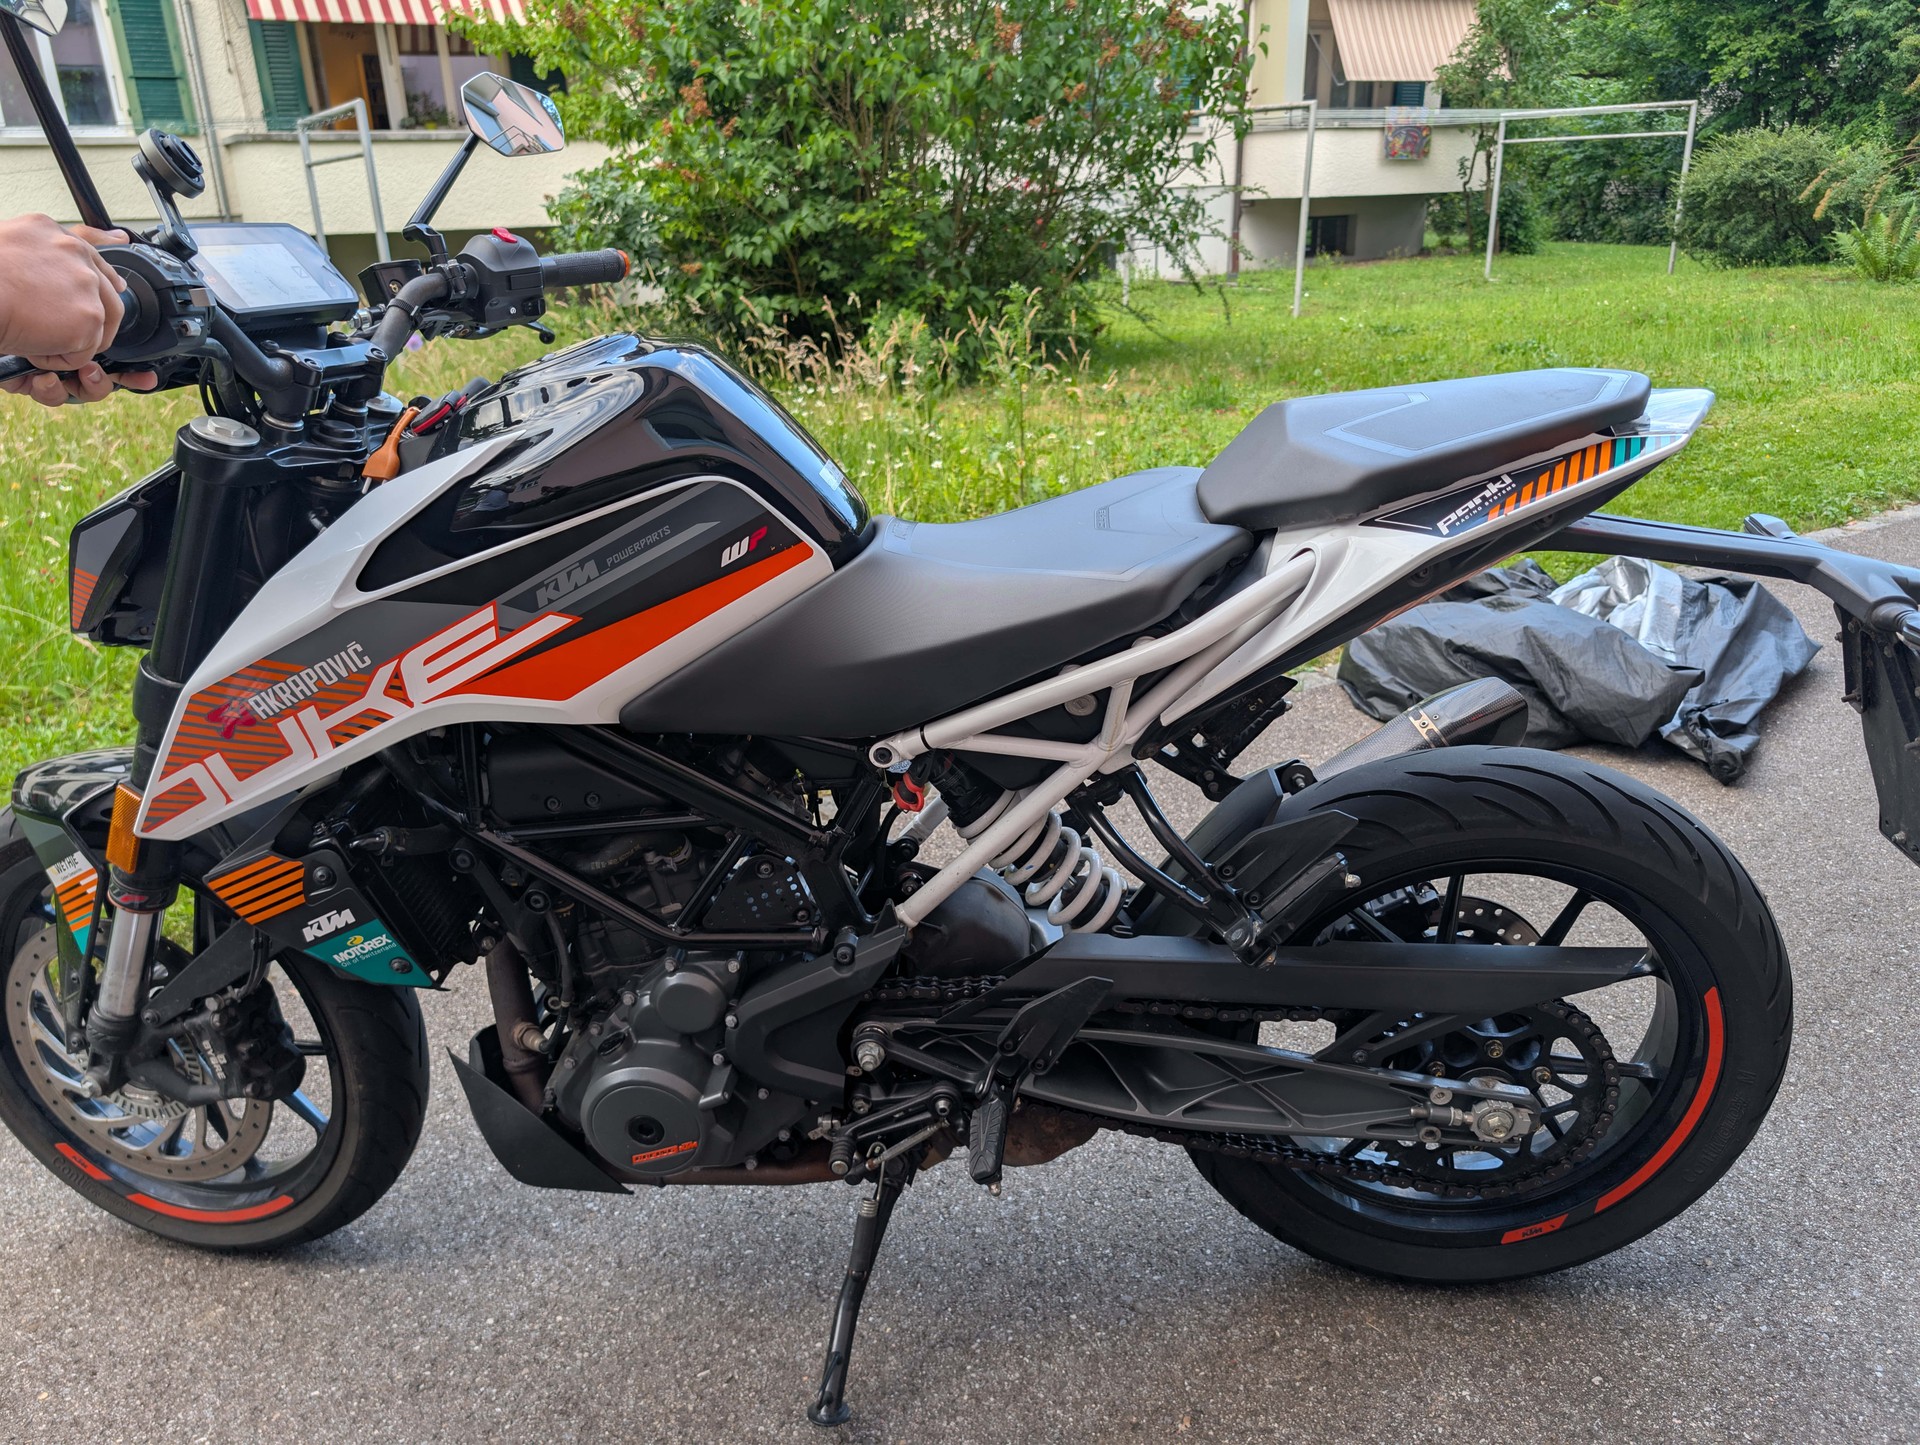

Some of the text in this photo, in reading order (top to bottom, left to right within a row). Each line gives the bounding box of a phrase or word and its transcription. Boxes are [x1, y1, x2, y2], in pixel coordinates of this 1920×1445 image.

[1437, 474, 1513, 536] pankl
[142, 602, 579, 832] DUKE
[302, 908, 356, 943] KTM
[332, 934, 392, 963] MOTOREX
